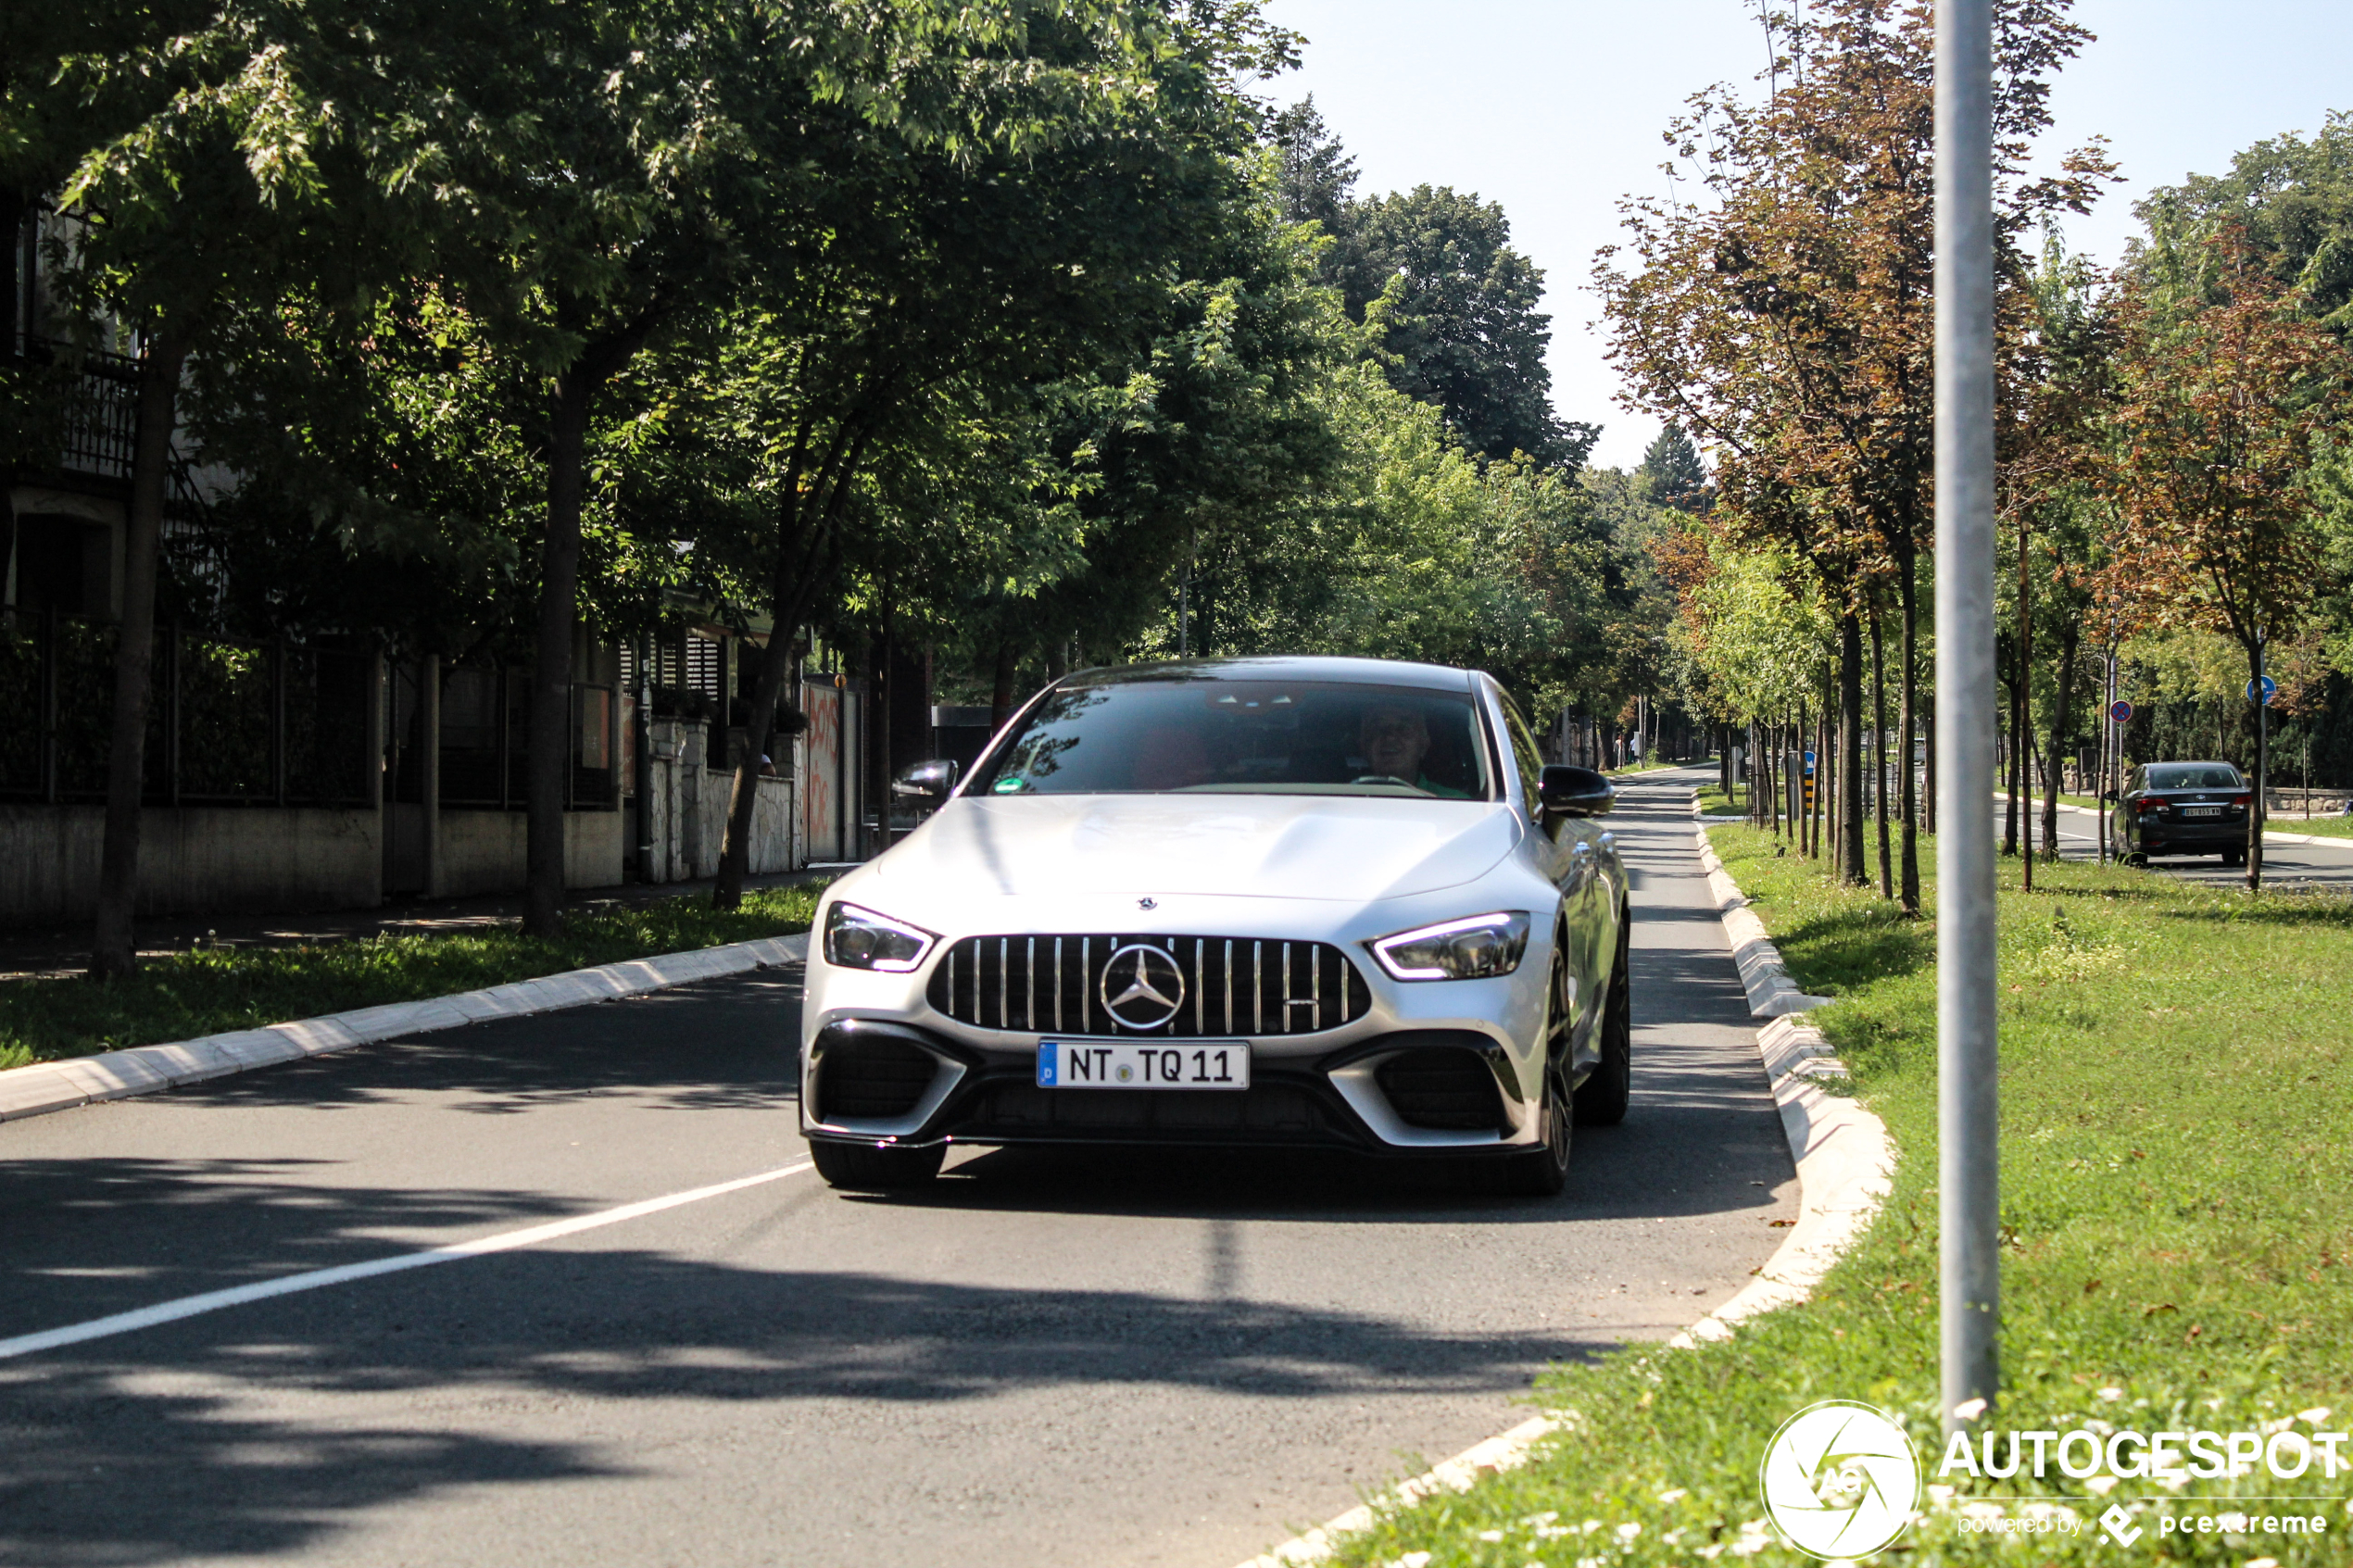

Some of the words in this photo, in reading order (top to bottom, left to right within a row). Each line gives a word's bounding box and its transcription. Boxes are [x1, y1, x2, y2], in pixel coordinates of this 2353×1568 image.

[1044, 1067, 1052, 1079] D
[1070, 1048, 1113, 1081] NT
[1139, 1049, 1181, 1082] TQ
[1192, 1050, 1233, 1083] 11
